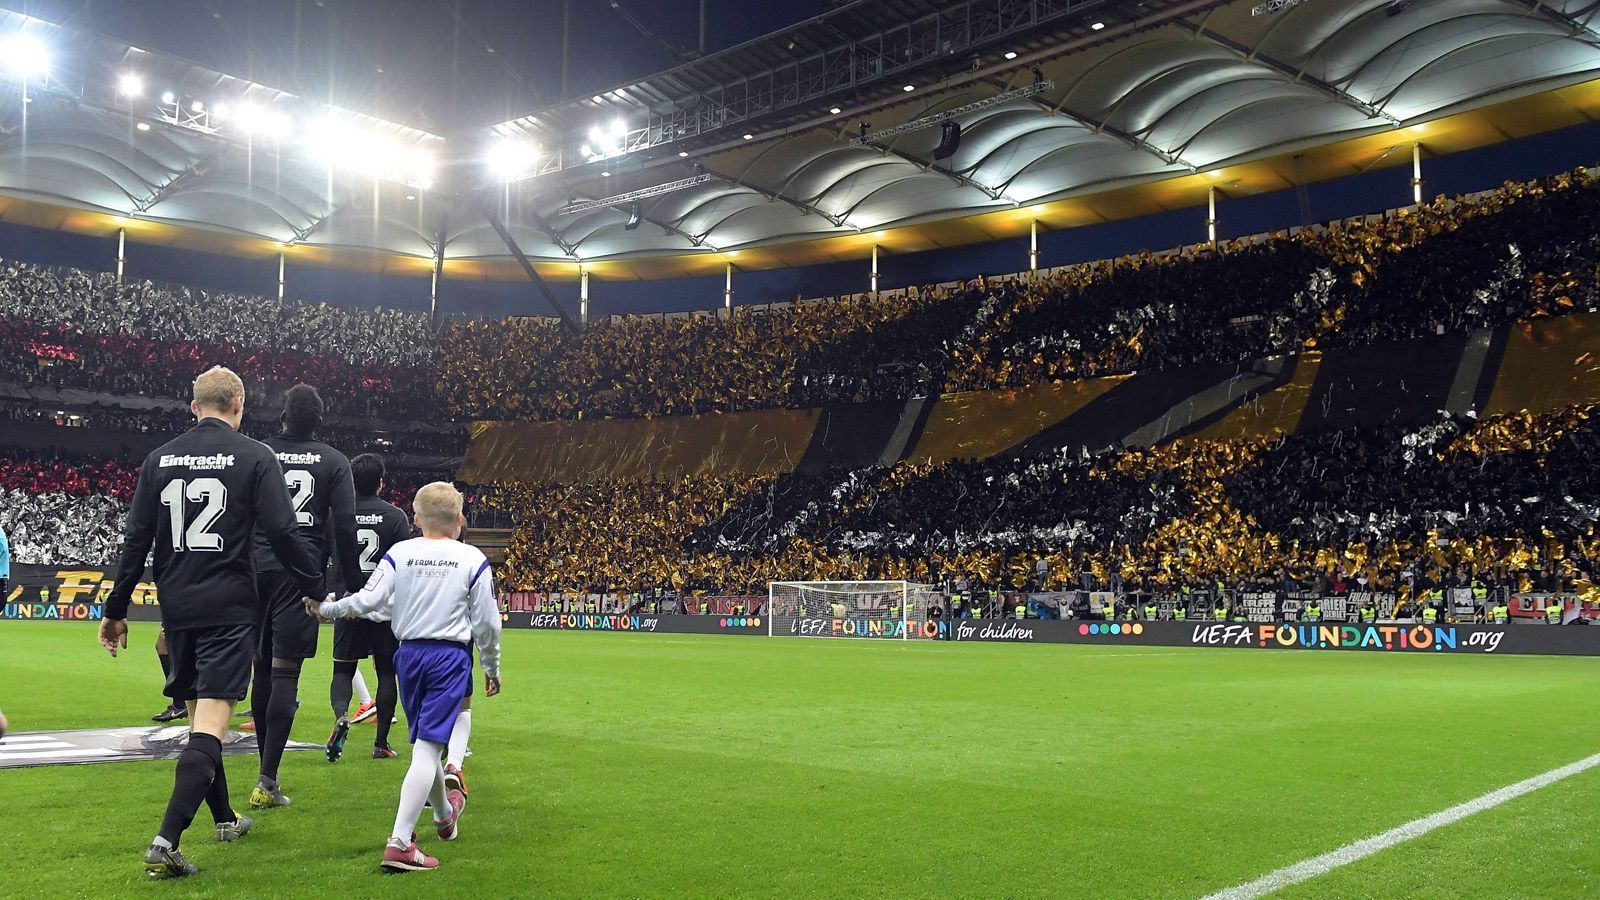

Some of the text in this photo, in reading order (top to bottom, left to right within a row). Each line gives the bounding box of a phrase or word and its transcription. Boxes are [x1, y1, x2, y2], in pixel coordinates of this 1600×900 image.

[159, 453, 235, 467] Eintracht
[274, 450, 321, 463] ntracht
[284, 469, 315, 526] 2
[160, 477, 227, 552] 12
[355, 513, 383, 523] racht
[356, 529, 380, 572] 2
[4, 603, 102, 619] UNDATION
[530, 613, 659, 631] UEFA FOUNDATION .org
[832, 618, 952, 639] FOUNDATION
[957, 620, 977, 640] for
[980, 622, 1034, 640] children
[1192, 623, 1505, 652] UEFA FOUNDATION .org
